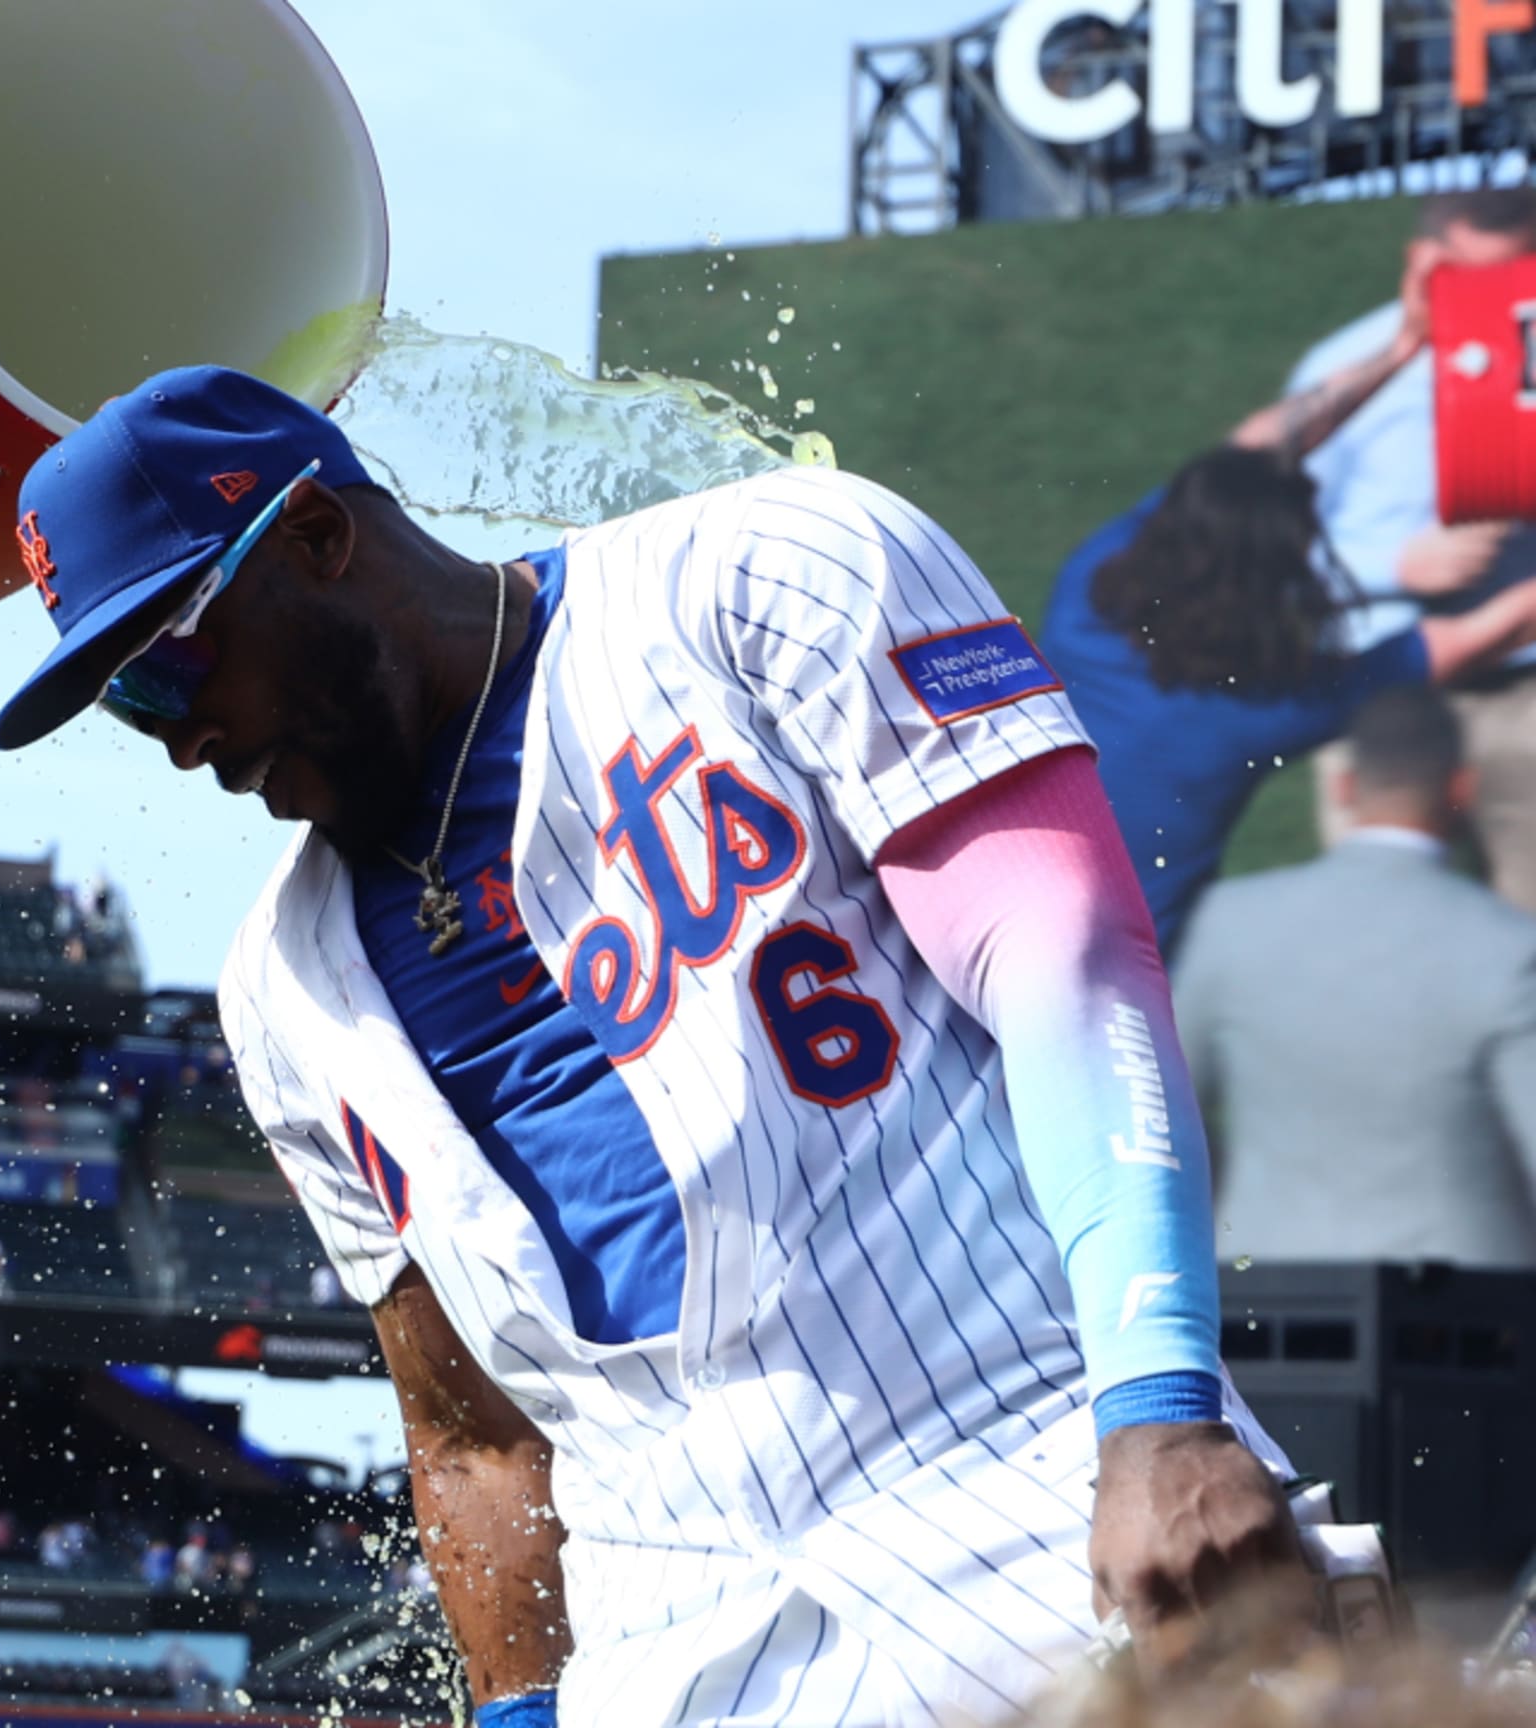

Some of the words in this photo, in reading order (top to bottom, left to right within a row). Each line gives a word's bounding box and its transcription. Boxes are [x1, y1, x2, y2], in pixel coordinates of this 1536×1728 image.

[942, 656, 1040, 693] Presbyterian
[563, 722, 807, 1068] ets
[748, 920, 901, 1109] 6
[1104, 1001, 1182, 1171] Franklin
